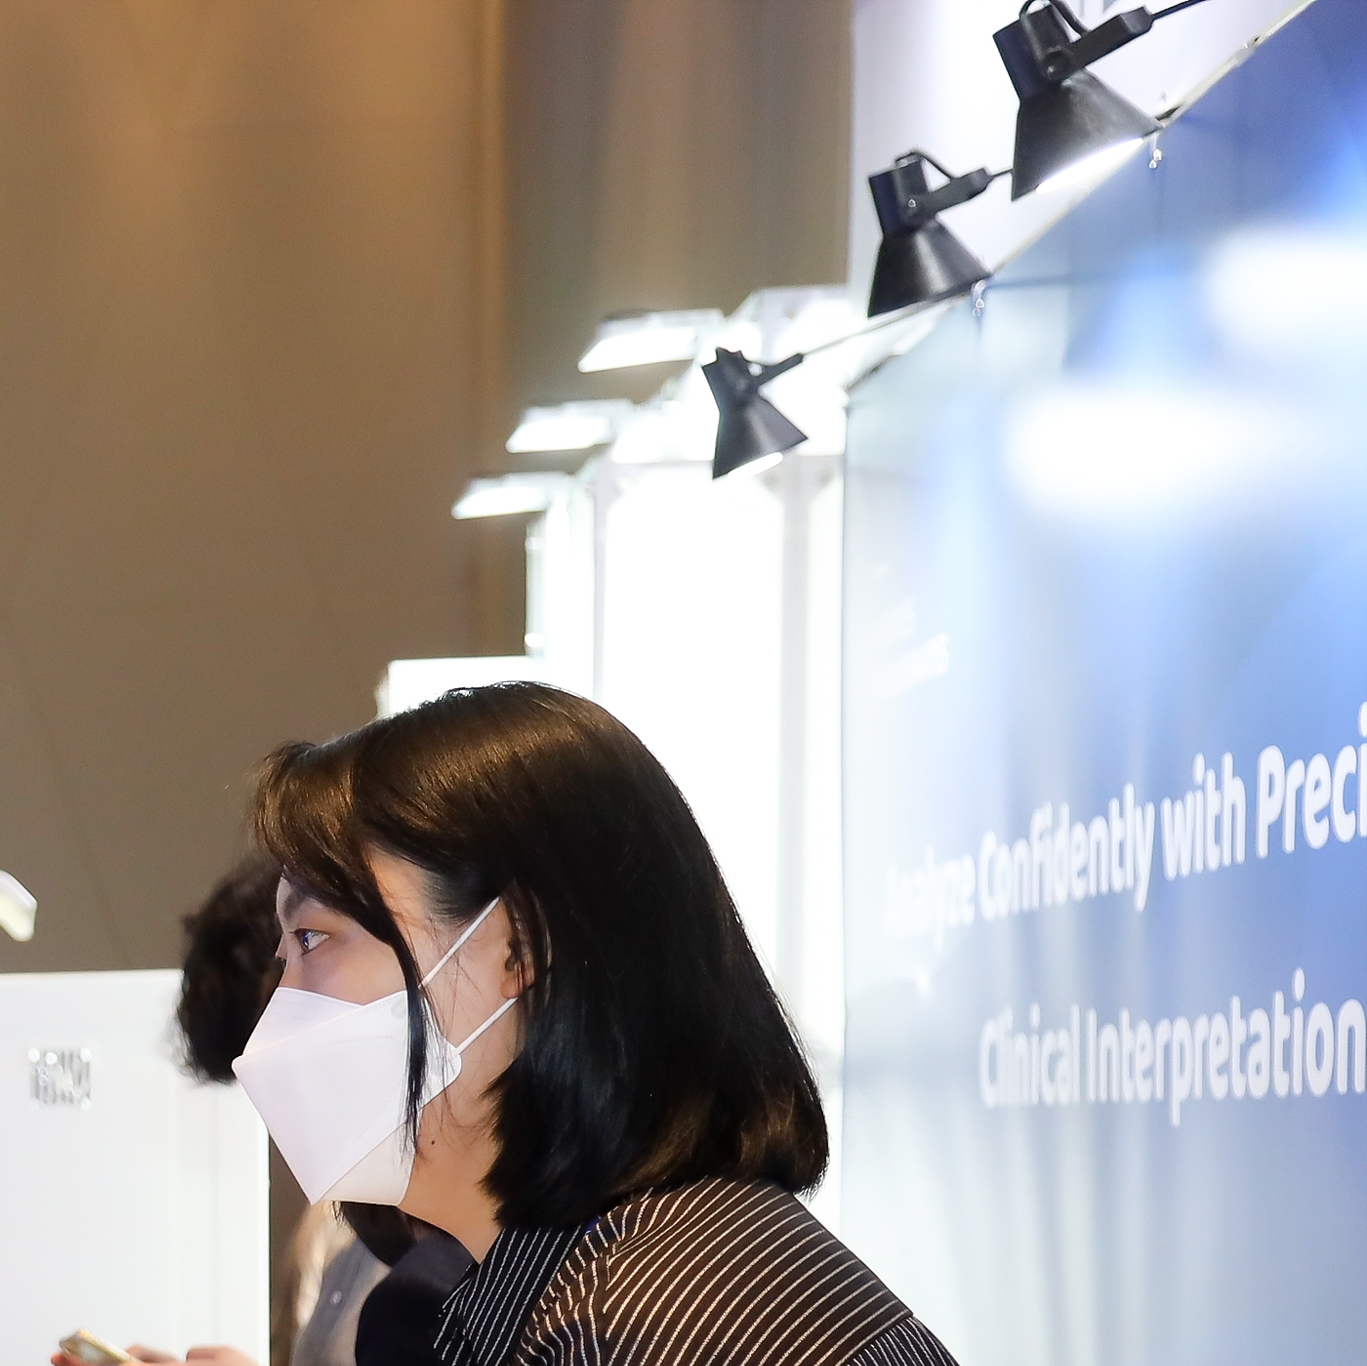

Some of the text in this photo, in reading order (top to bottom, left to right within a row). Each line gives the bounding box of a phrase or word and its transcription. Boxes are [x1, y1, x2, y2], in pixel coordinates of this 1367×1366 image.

[978, 783, 1156, 920] Confidently
[1160, 752, 1247, 881] with
[979, 968, 1367, 1128] Clinical Interpretation
